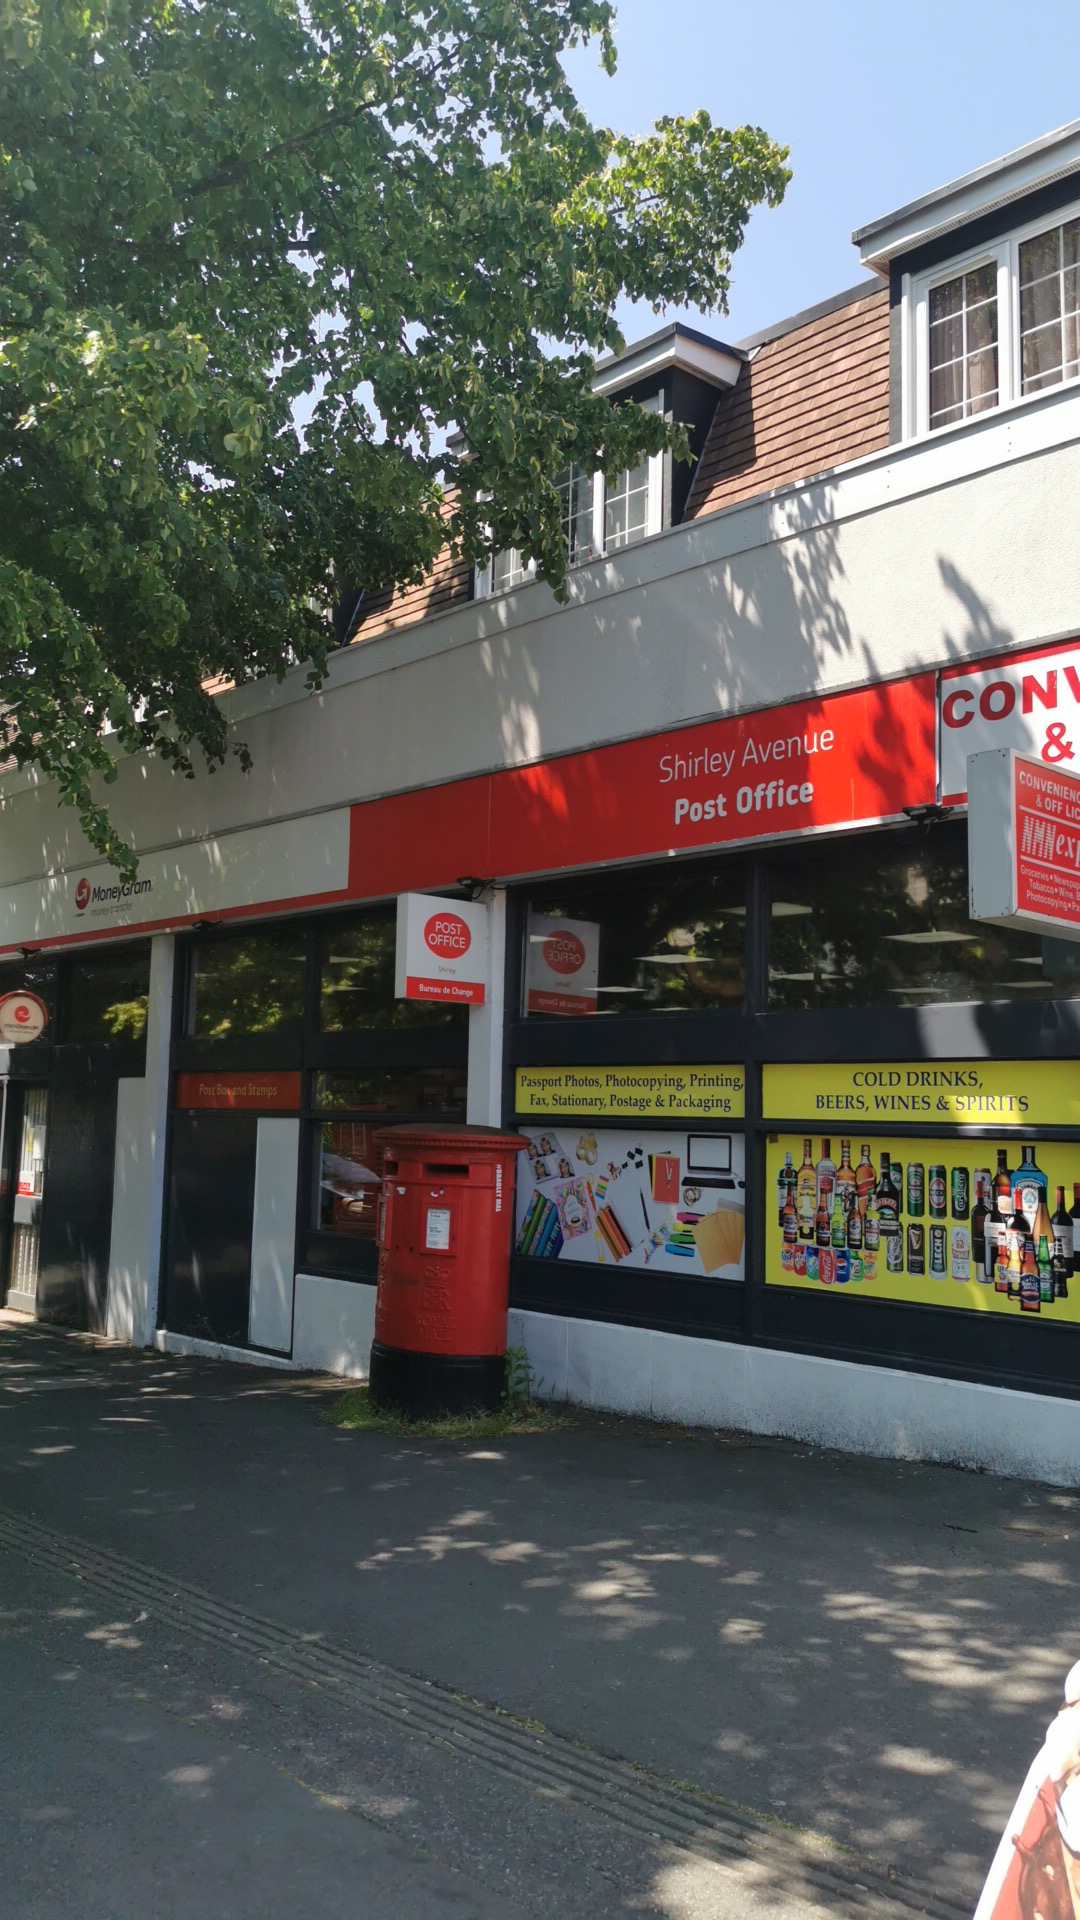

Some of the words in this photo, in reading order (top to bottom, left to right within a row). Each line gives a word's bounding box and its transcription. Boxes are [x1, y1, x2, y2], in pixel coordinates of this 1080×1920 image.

[1041, 722, 1075, 762] &
[659, 748, 735, 783] Shirley
[742, 729, 834, 767] Avenue
[674, 793, 727, 825] Post
[736, 779, 814, 814] Office
[1036, 794, 1042, 808] &
[1044, 797, 1063, 814] OFF
[1020, 864, 1049, 881] Groceries
[92, 880, 152, 902] MoneyGram
[1029, 878, 1054, 894] Tobacco
[90, 905, 109, 917] money
[110, 901, 134, 913] transfer
[1026, 890, 1068, 911] Photocopying
[435, 921, 463, 935] POST
[428, 933, 466, 948] OFFICE
[438, 966, 456, 975] Shirley
[419, 984, 441, 993] Bureau
[452, 987, 473, 997] Change
[520, 1075, 562, 1091] Passport
[564, 1074, 602, 1089] Photos,
[605, 1074, 686, 1091] Photocopying,
[689, 1073, 744, 1092] Printing,
[852, 1071, 900, 1087] COLD
[906, 1071, 983, 1089] DRINKS,
[199, 1083, 215, 1095] Post
[216, 1083, 231, 1096] Box
[232, 1084, 246, 1096] and
[248, 1083, 277, 1098] Stamps
[530, 1093, 549, 1108] Fax,
[551, 1093, 606, 1110] Stationary,
[609, 1094, 651, 1111] Postage
[654, 1095, 665, 1107] &
[668, 1094, 731, 1112] Packaging
[815, 1094, 869, 1112] BEERS,
[874, 1095, 931, 1110] WINES
[936, 1095, 950, 1111] &
[955, 1095, 1029, 1112] SPIRITS
[954, 1173, 966, 1211] Carlsberg
[934, 1238, 943, 1264] LECH
